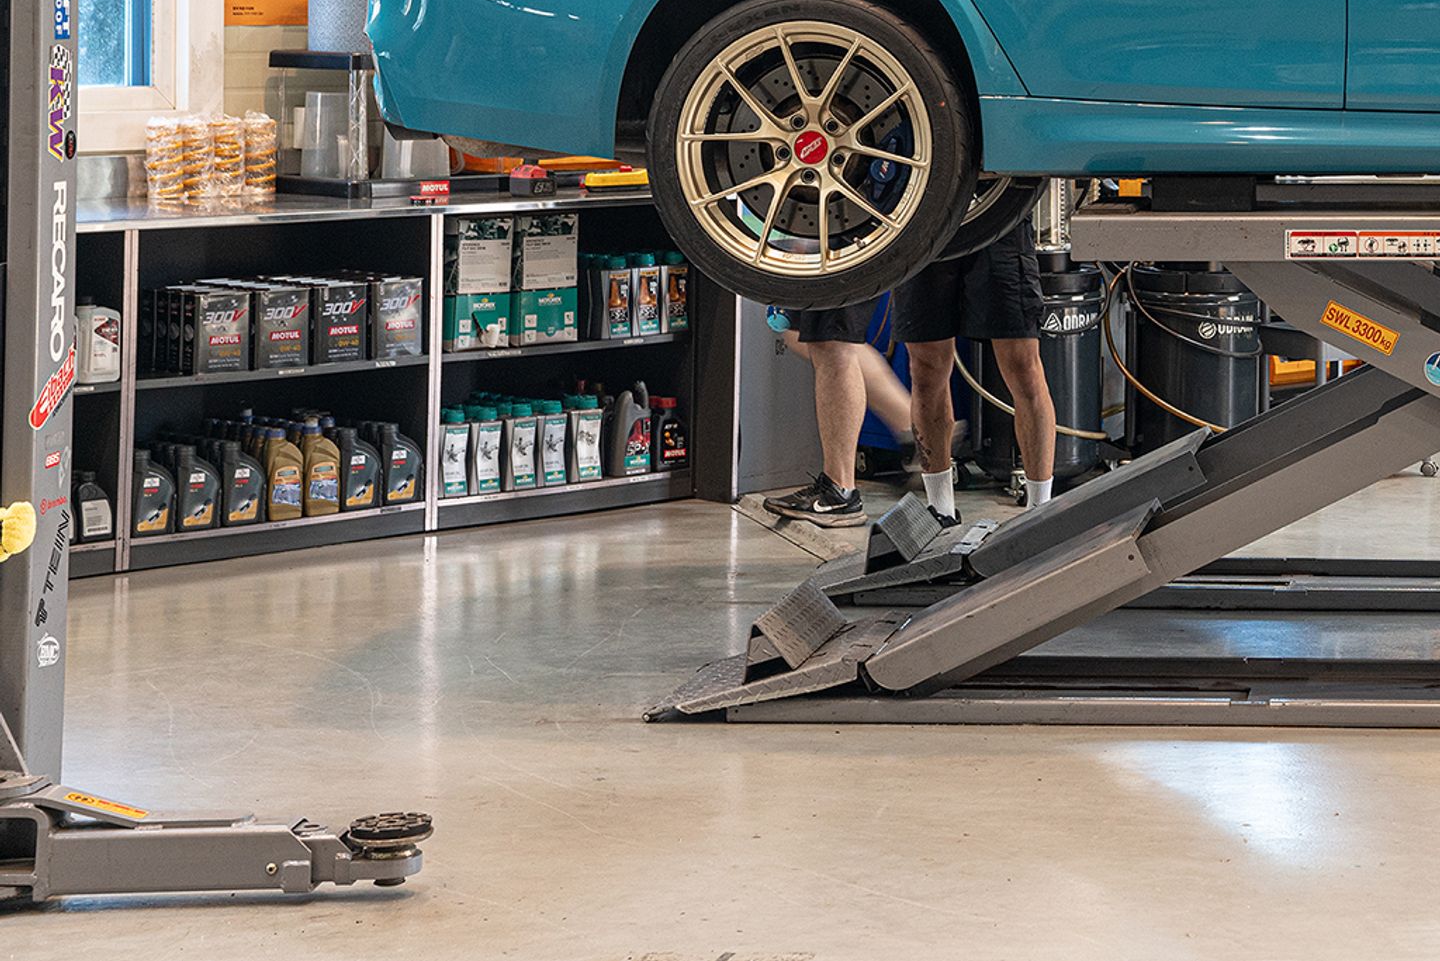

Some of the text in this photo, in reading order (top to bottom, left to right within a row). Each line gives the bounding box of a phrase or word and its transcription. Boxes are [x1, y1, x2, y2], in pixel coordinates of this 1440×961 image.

[48, 67, 64, 162] KW
[422, 184, 449, 192] MOTUL
[50, 180, 68, 362] RECARO
[322, 298, 366, 316] 300V
[380, 294, 421, 311] 300V
[203, 307, 249, 325] 300V
[263, 303, 309, 321] 300V
[329, 327, 358, 335] MOTUL
[387, 321, 414, 329] MOTUL
[1326, 307, 1392, 350] SWL 3300 kg
[211, 336, 240, 345] MOTUL
[271, 331, 300, 340] MOTUL
